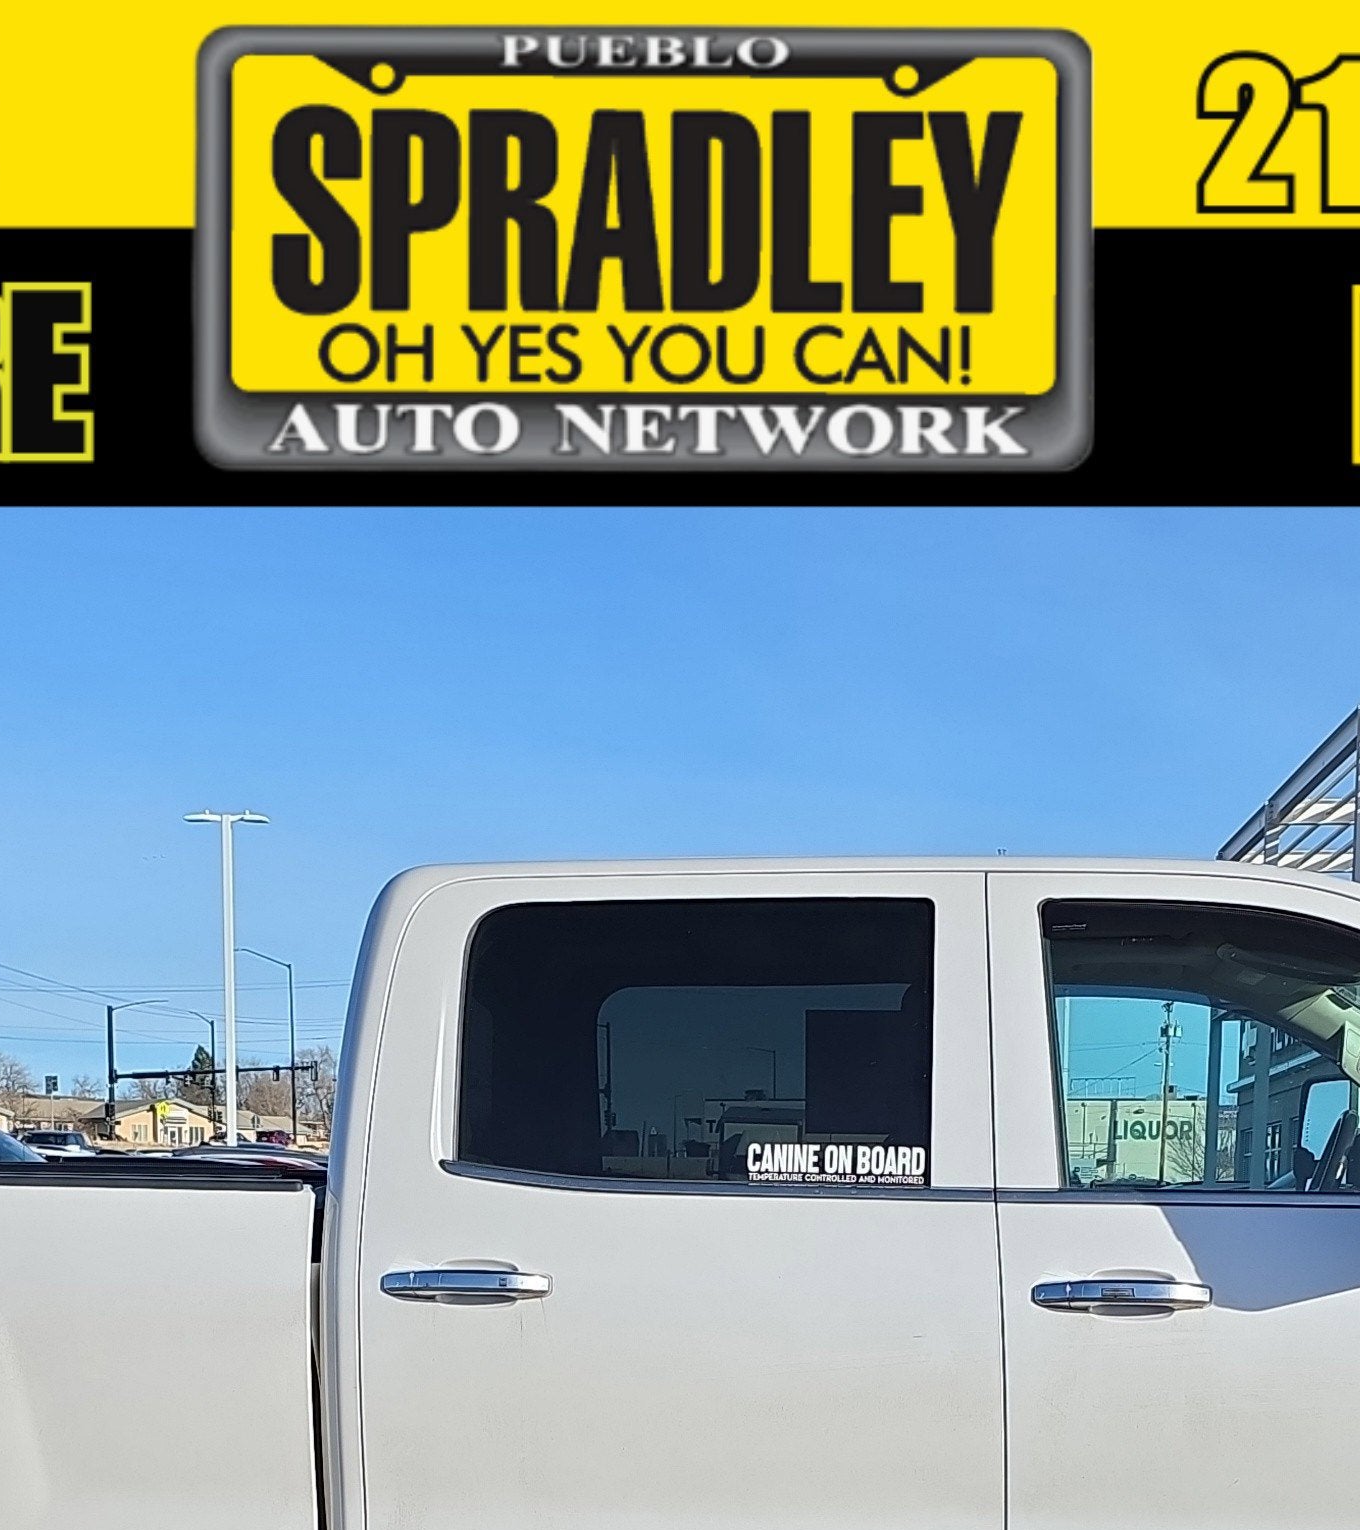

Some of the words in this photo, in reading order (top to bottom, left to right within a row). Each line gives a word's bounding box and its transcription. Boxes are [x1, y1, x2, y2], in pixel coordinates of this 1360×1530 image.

[1114, 1120, 1192, 1140] LIQUOR
[747, 1142, 820, 1174] CANINE
[824, 1144, 853, 1175] ON
[856, 1145, 926, 1176] BOARD
[748, 1172, 803, 1182] TEMPERATURE
[805, 1173, 856, 1184] CONTROLLED
[858, 1175, 876, 1184] AND
[877, 1175, 925, 1185] MONITORED
